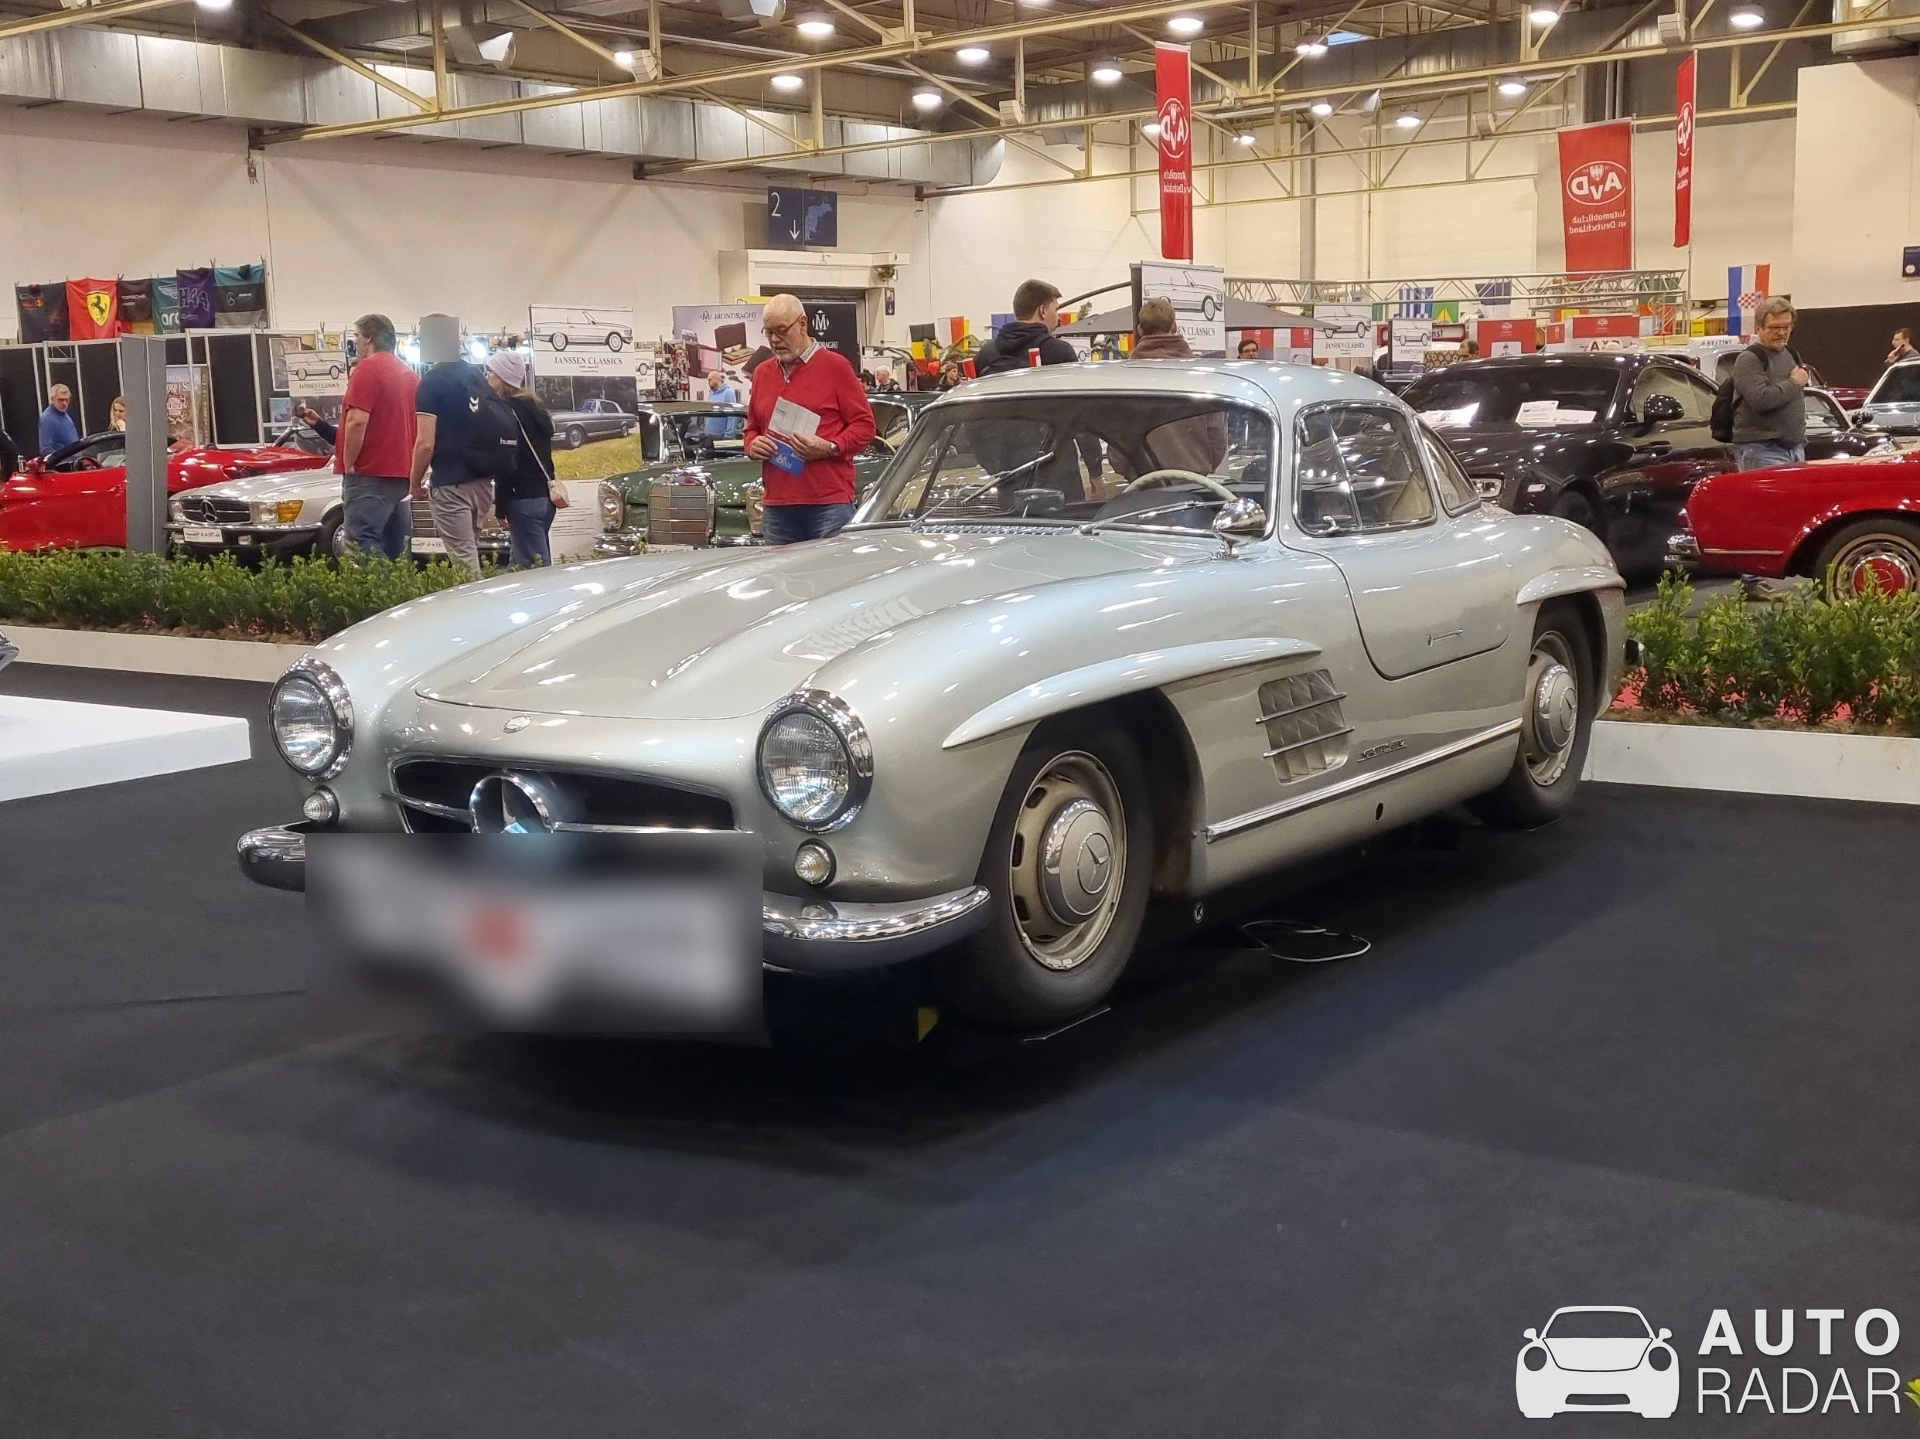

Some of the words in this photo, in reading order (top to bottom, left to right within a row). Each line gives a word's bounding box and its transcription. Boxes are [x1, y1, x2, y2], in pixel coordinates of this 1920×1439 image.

[771, 192, 781, 217] 2
[554, 356, 586, 365] JANSSEN
[588, 357, 622, 366] CLASSICS
